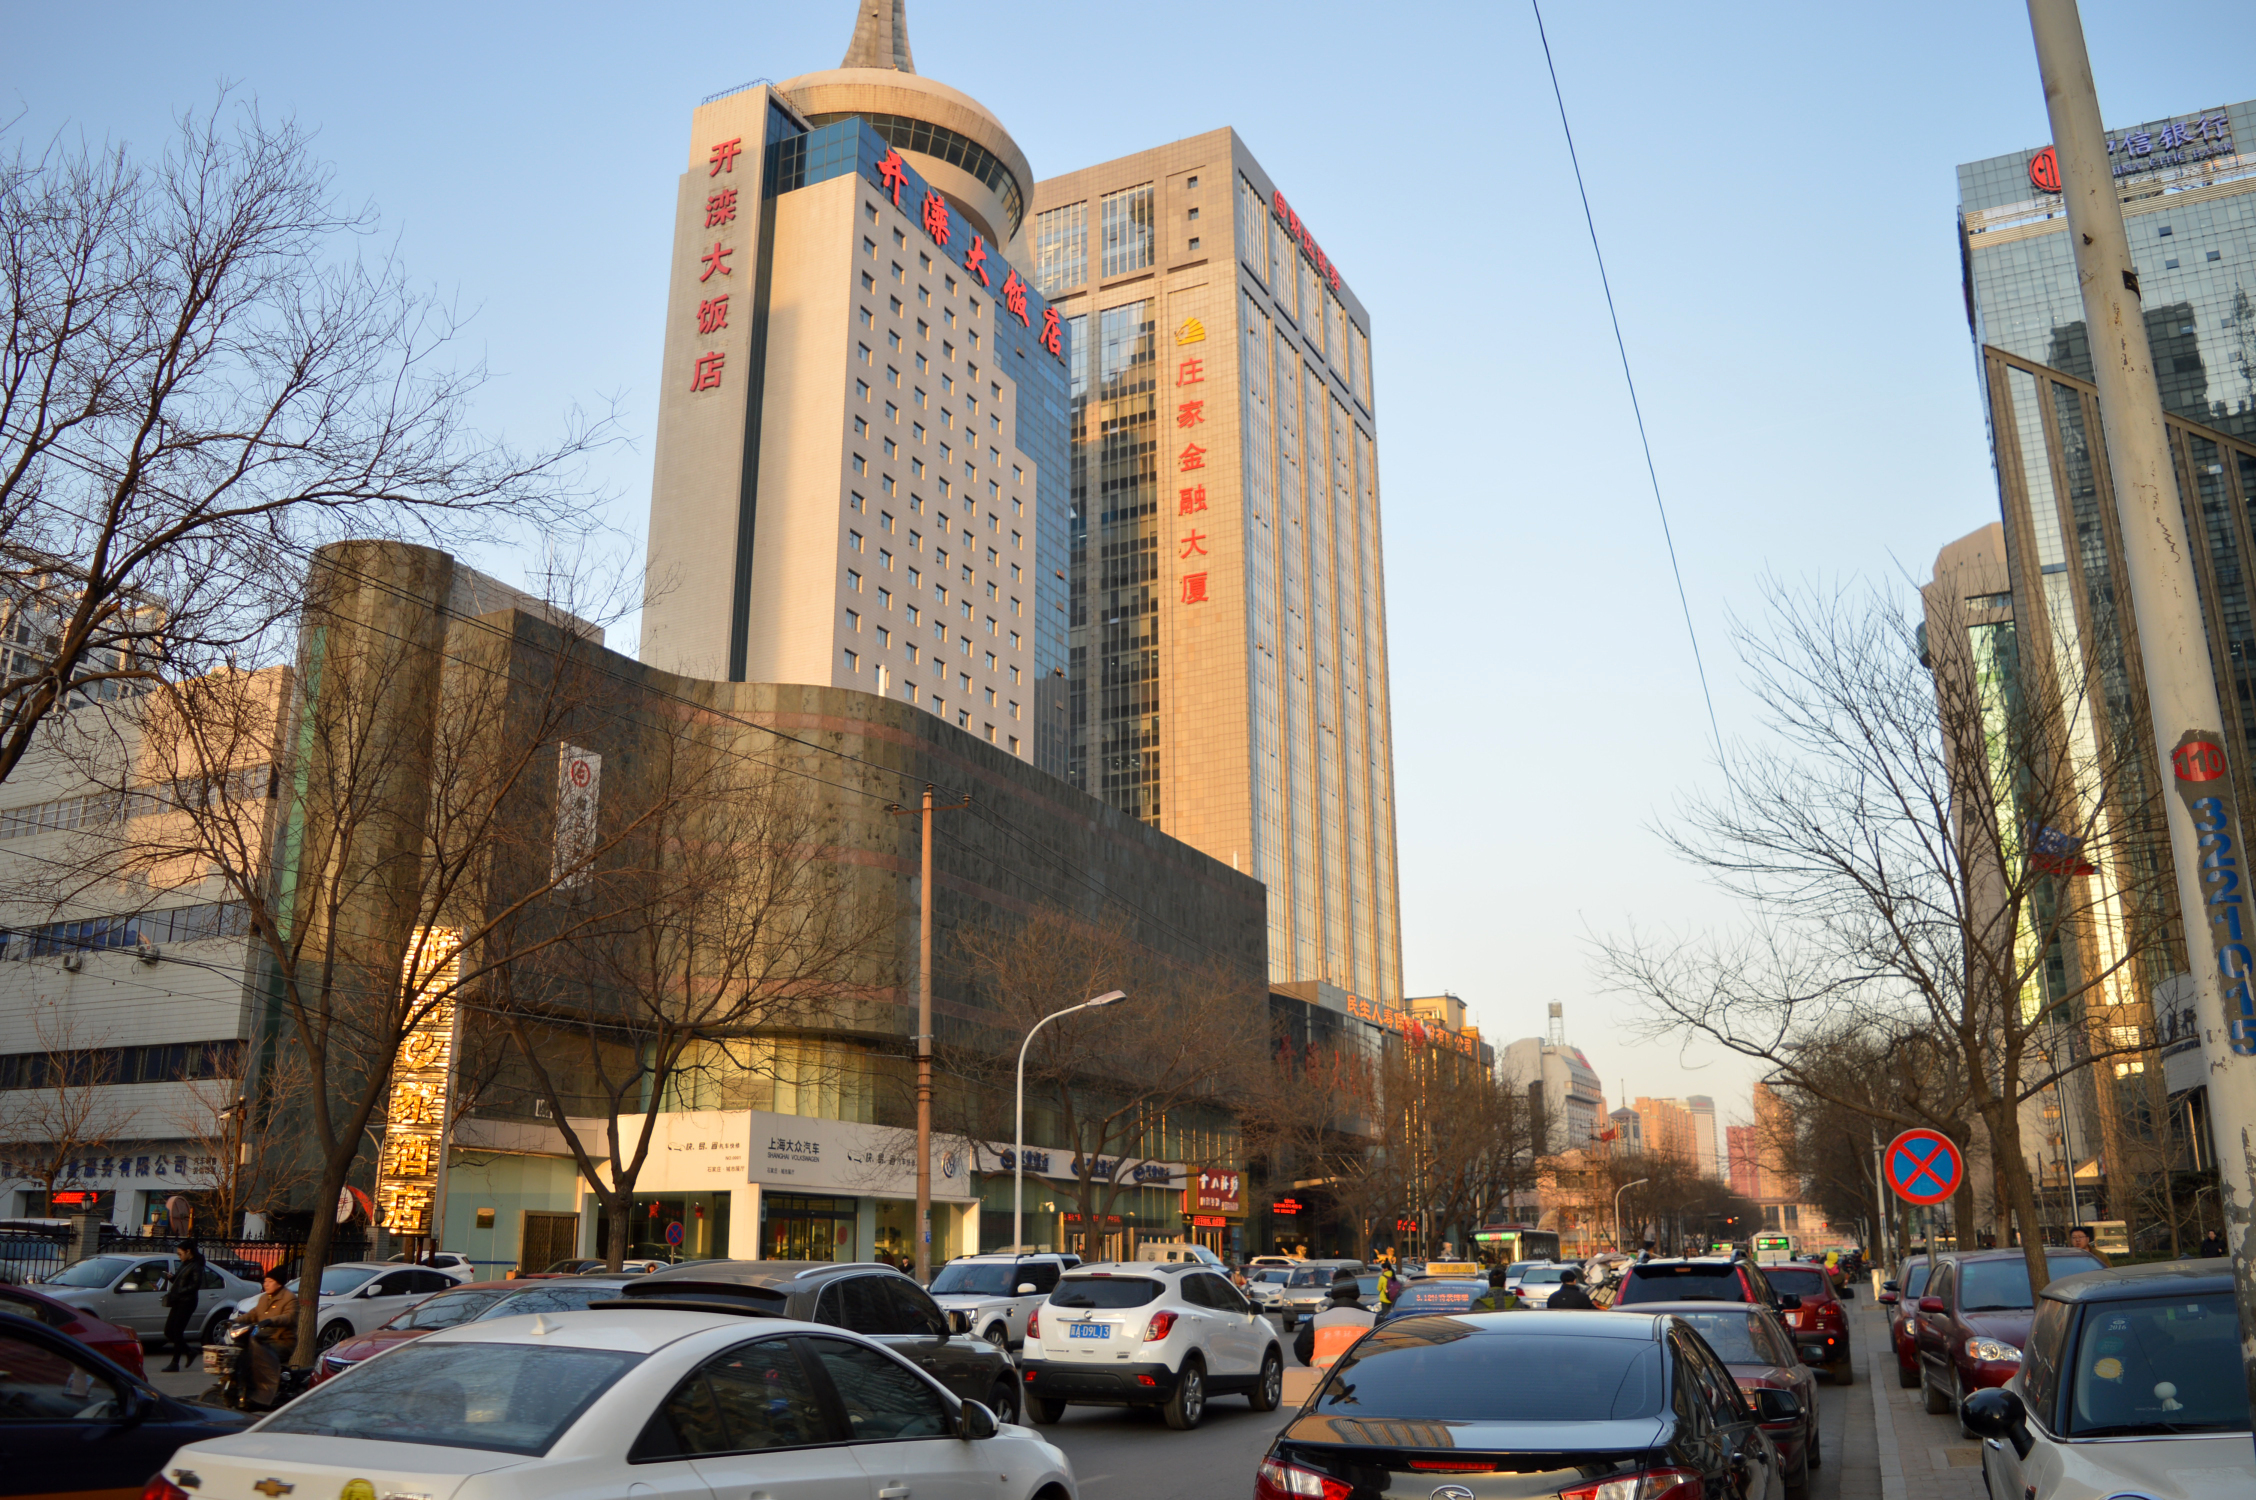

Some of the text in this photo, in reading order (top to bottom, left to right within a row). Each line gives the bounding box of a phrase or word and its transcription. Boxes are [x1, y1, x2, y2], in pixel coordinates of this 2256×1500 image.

[2107, 114, 2228, 156] 信银行
[689, 137, 742, 392] 开滦大饭店
[877, 149, 1062, 357] 开滦大饭店
[1176, 357, 1209, 604] 庄家金融大厦
[2175, 748, 2224, 776] 110
[2191, 797, 2256, 1056] 3221015
[767, 1136, 820, 1154] 上海大众汽车
[767, 1152, 820, 1163] SHANGHAI VOLKSWAGEN
